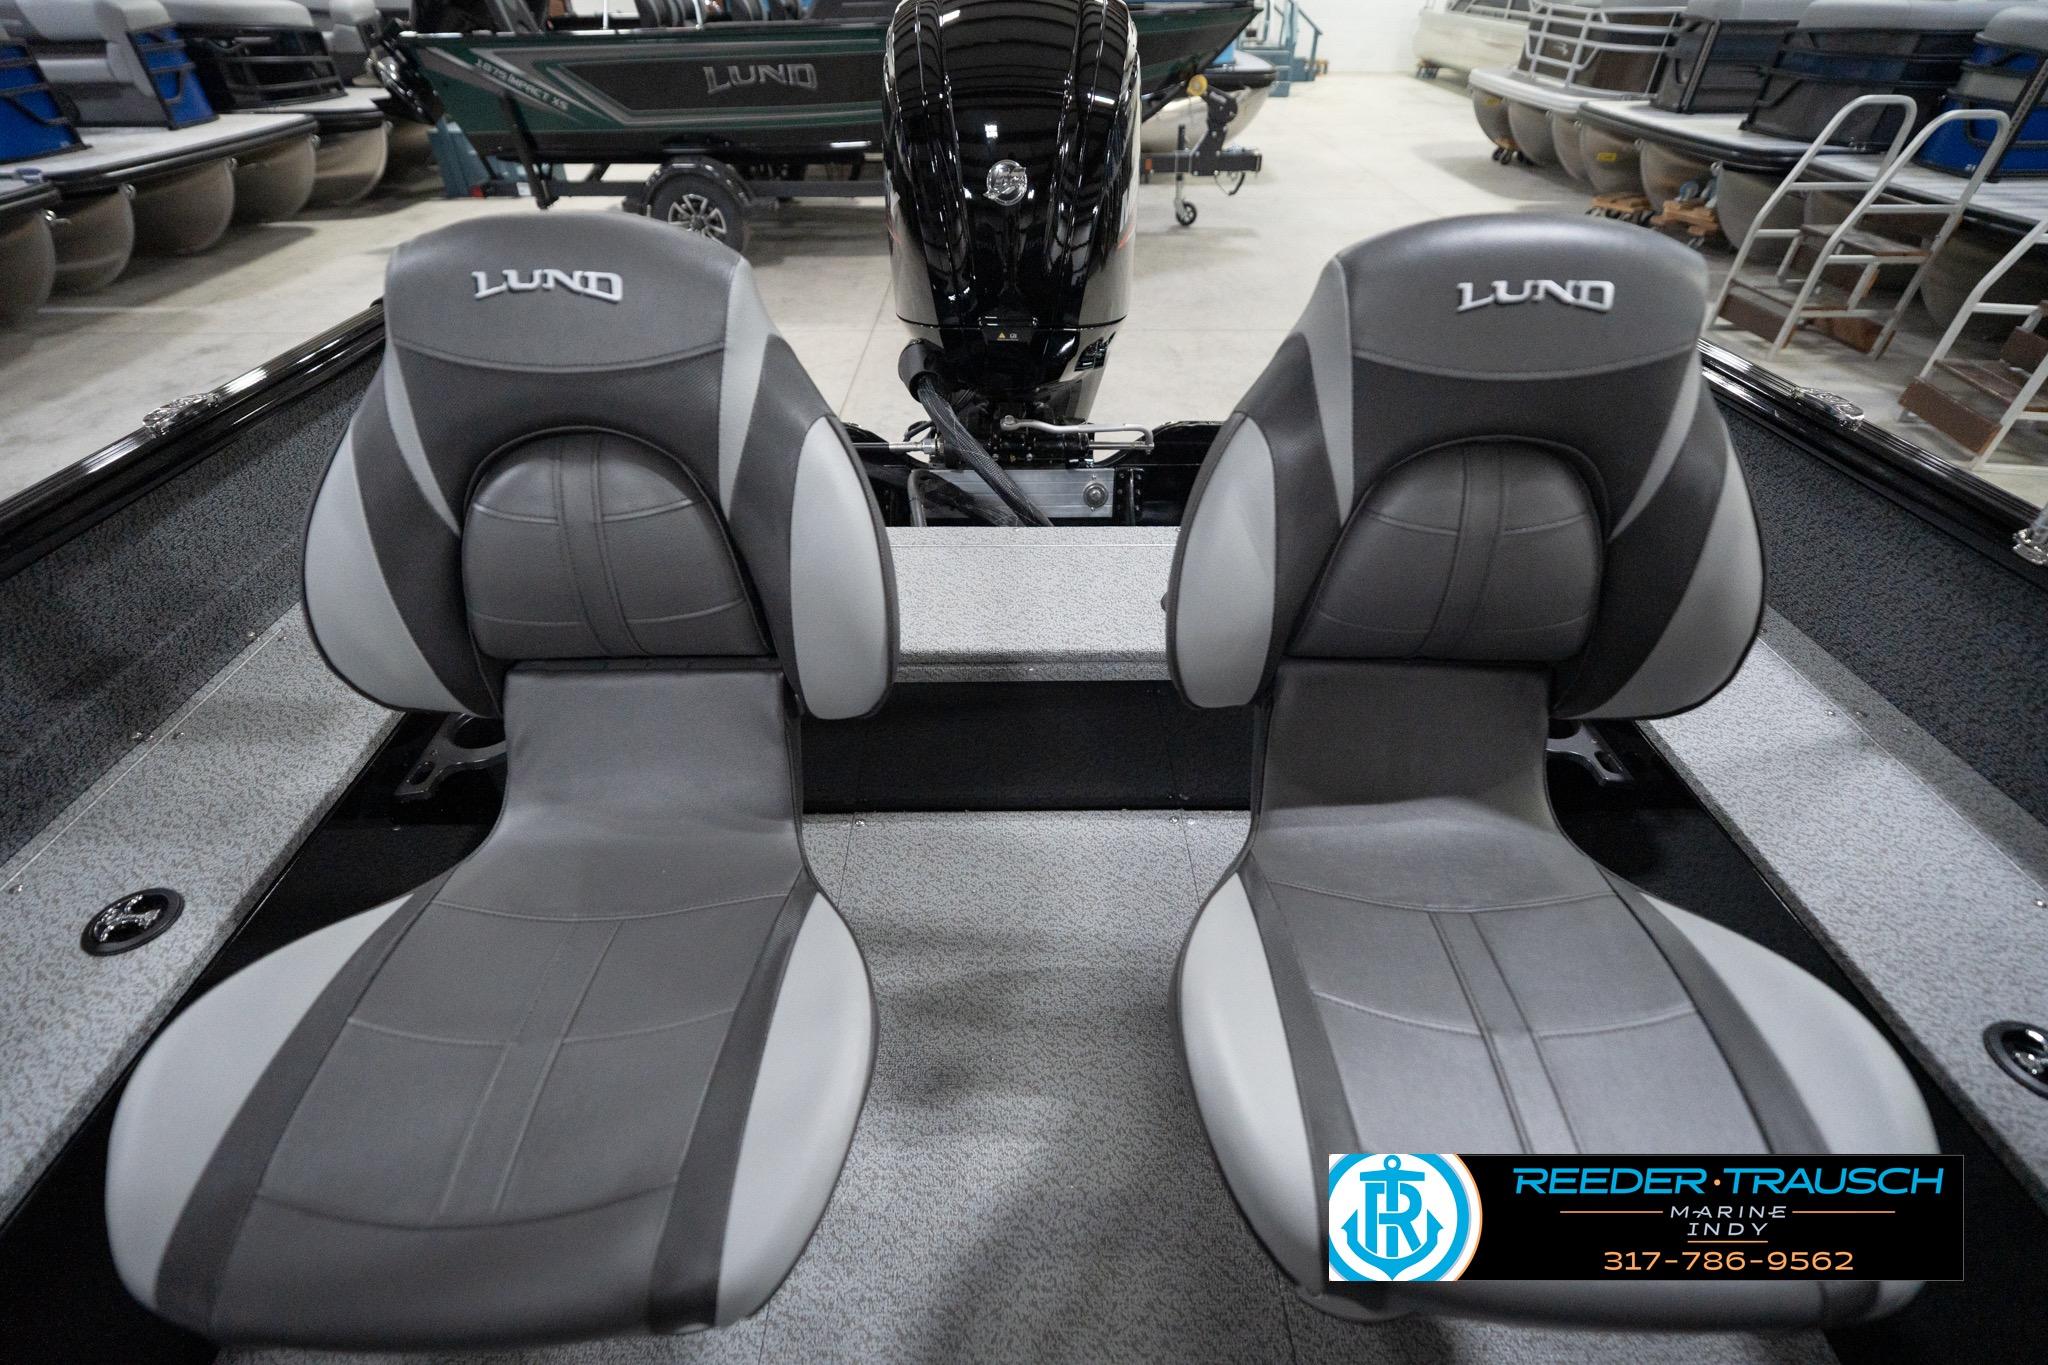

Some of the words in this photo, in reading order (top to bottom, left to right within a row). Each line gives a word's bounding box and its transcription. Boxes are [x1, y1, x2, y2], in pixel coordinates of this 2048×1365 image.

[702, 63, 818, 95] LUND
[471, 268, 623, 302] LUND
[1456, 279, 1616, 313] LUND
